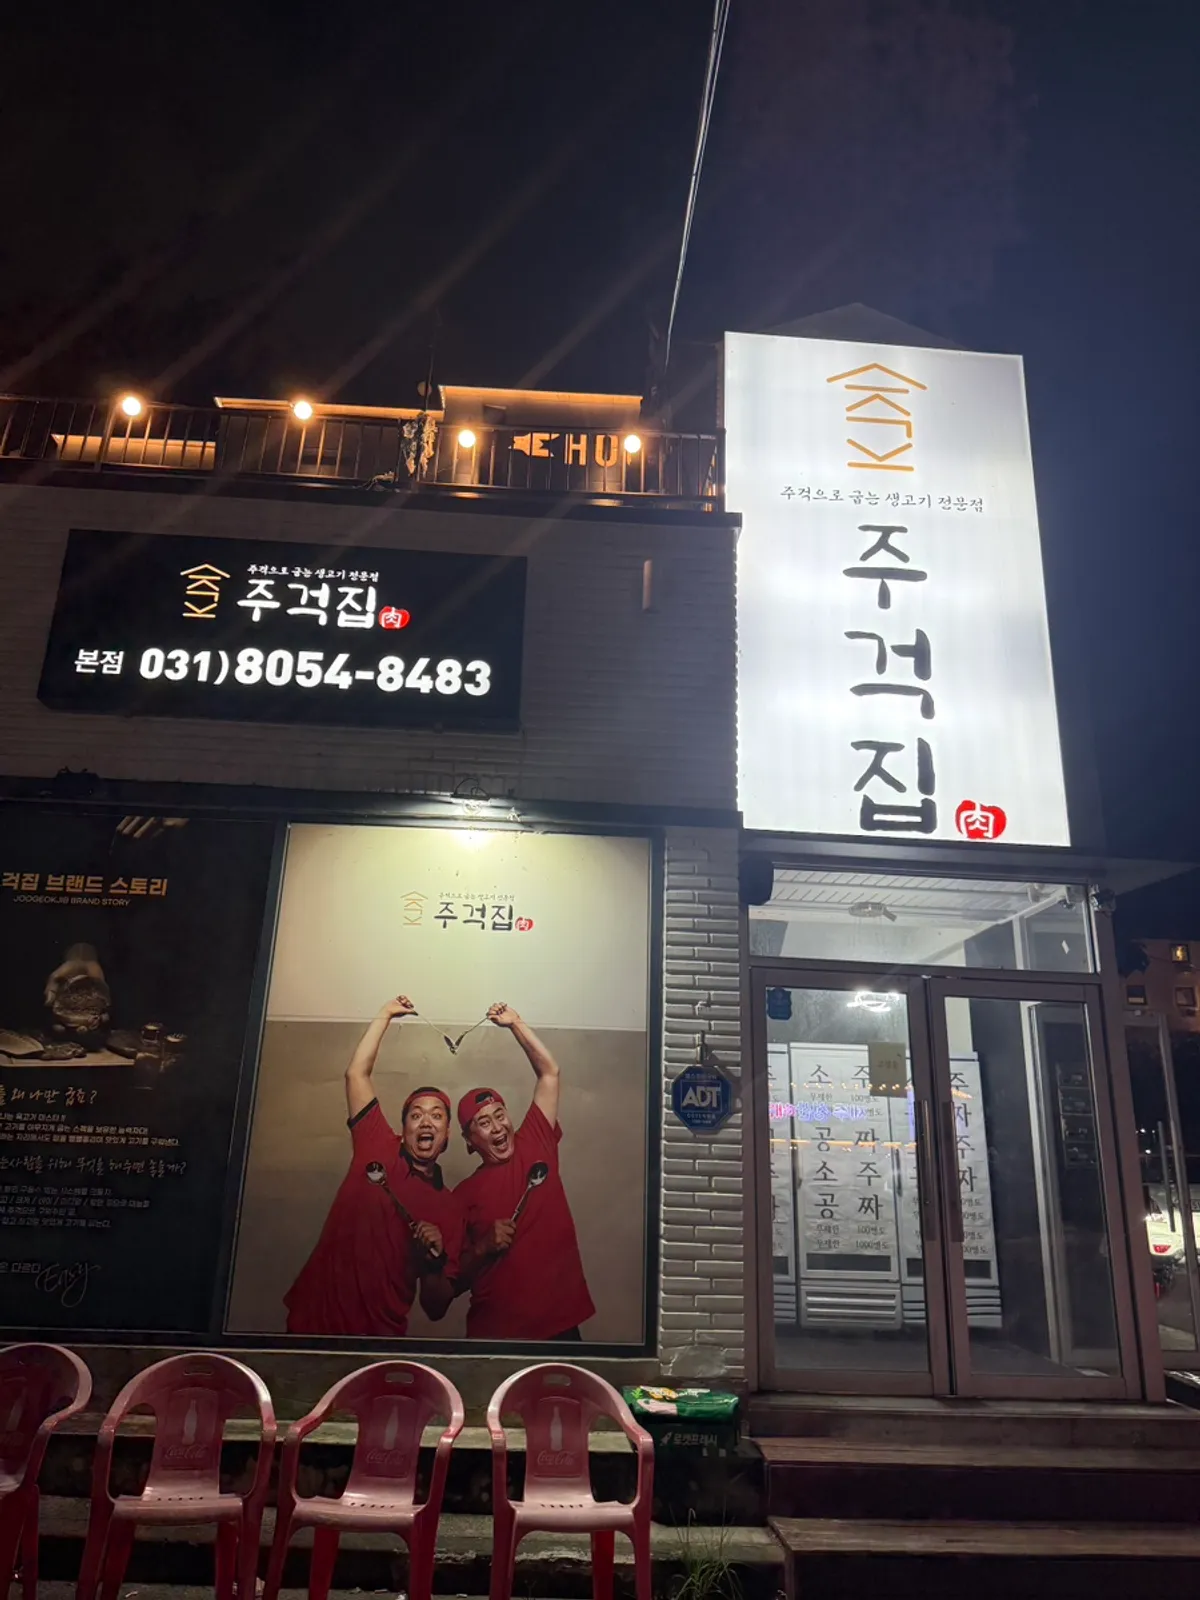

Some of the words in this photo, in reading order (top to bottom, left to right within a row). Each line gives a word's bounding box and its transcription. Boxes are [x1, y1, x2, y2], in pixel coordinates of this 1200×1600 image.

[564, 433, 640, 468] HO
[780, 486, 844, 502] 주걱으로
[849, 490, 880, 506] 굽는
[885, 492, 932, 509] 생고기
[938, 496, 984, 513] 전문점
[314, 569, 346, 580] 생고기
[237, 578, 377, 629] 주걱집
[74, 648, 125, 675] 본점
[842, 523, 938, 836] 주걱집
[45, 873, 104, 893] 브랜드
[109, 877, 168, 897] 스토리
[70, 896, 101, 905] BRAND
[101, 898, 131, 907] STORY
[433, 901, 514, 931] 주걱집
[681, 1086, 721, 1108] ADT
